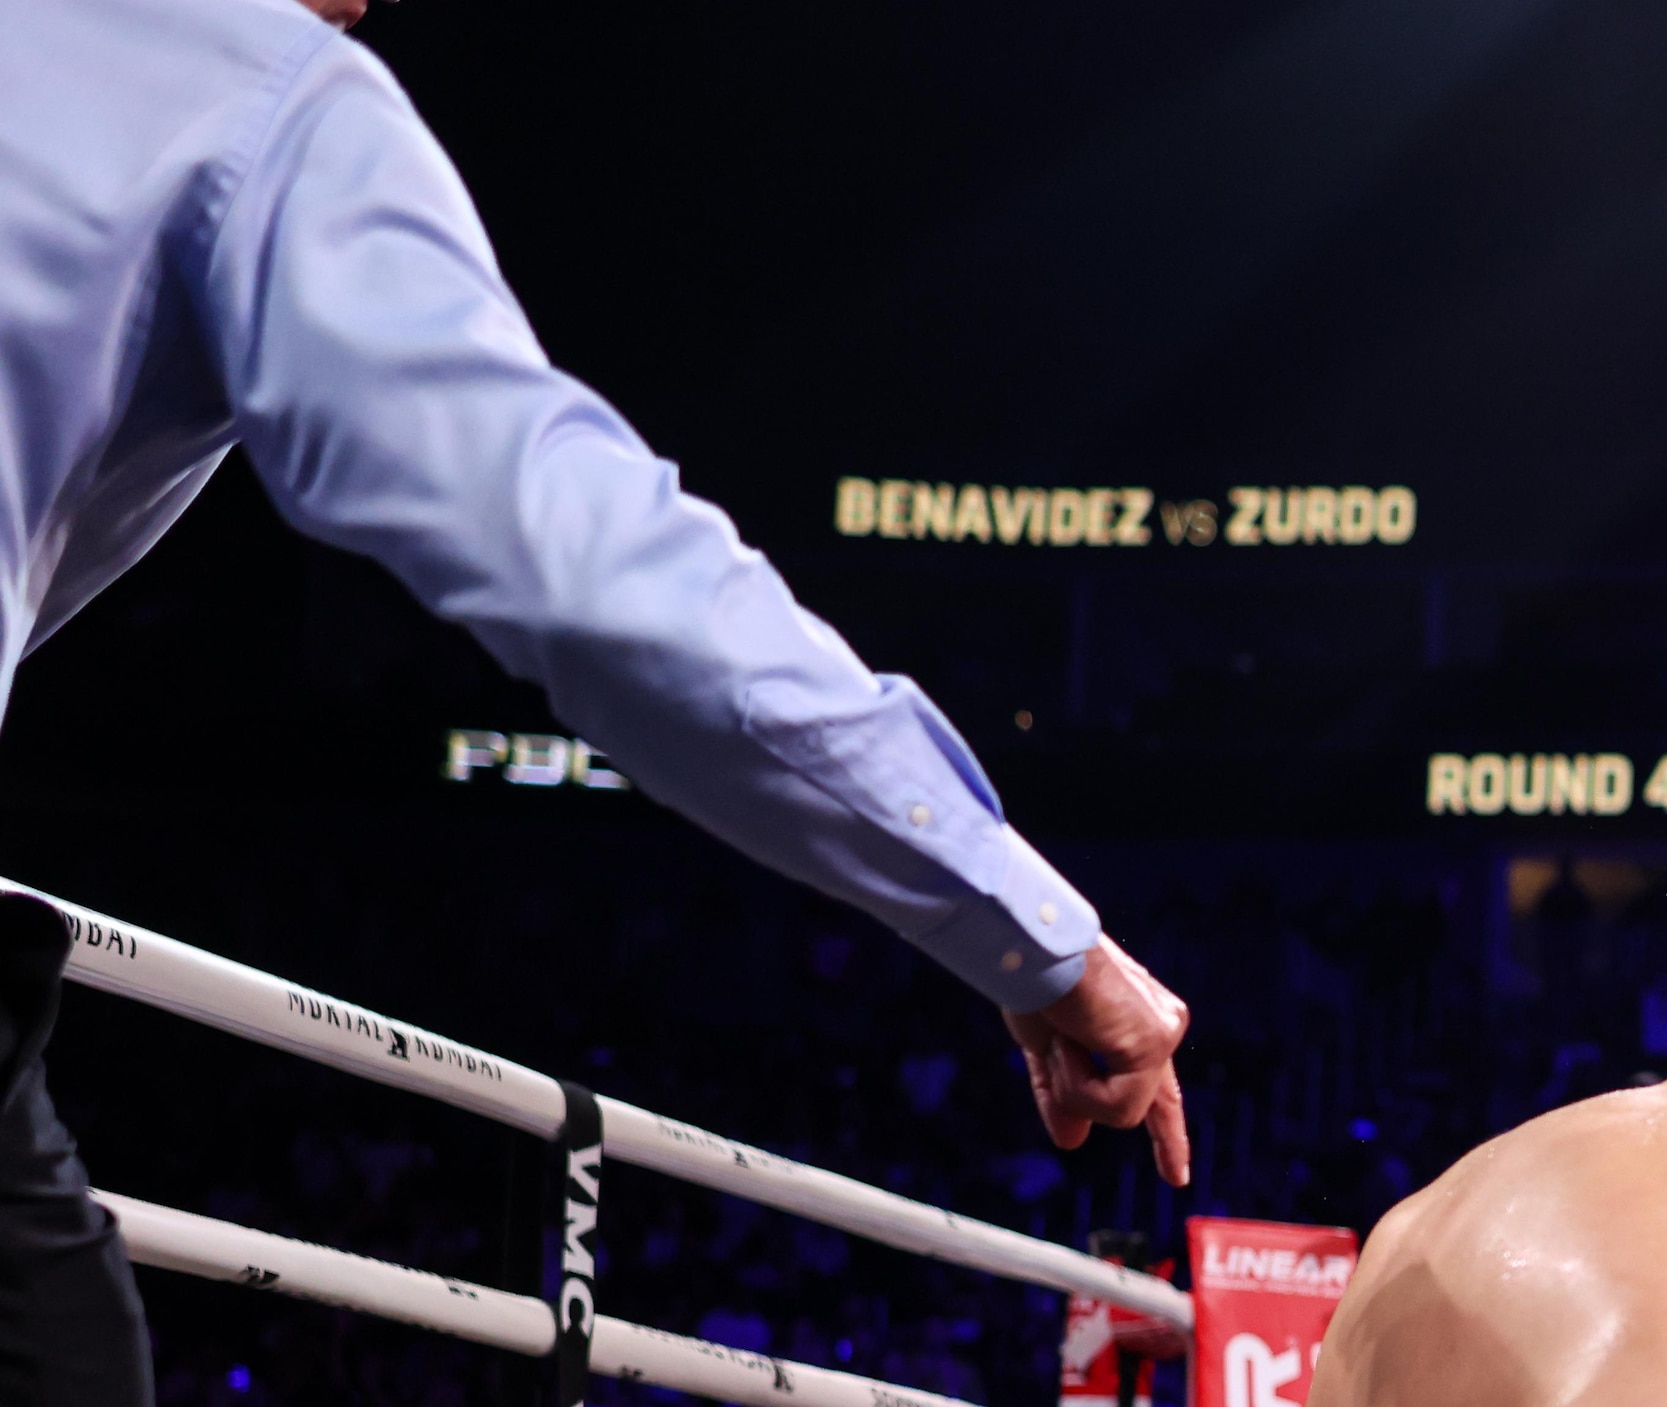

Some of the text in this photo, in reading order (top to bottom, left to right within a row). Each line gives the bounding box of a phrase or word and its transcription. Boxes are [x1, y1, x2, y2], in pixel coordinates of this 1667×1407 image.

[835, 478, 1152, 546] BENAVIDEZ
[1226, 486, 1417, 546] ZURDO
[1427, 754, 1632, 815] ROUND
[560, 1144, 601, 1339] VMC
[1204, 1243, 1349, 1286] LINEAR
